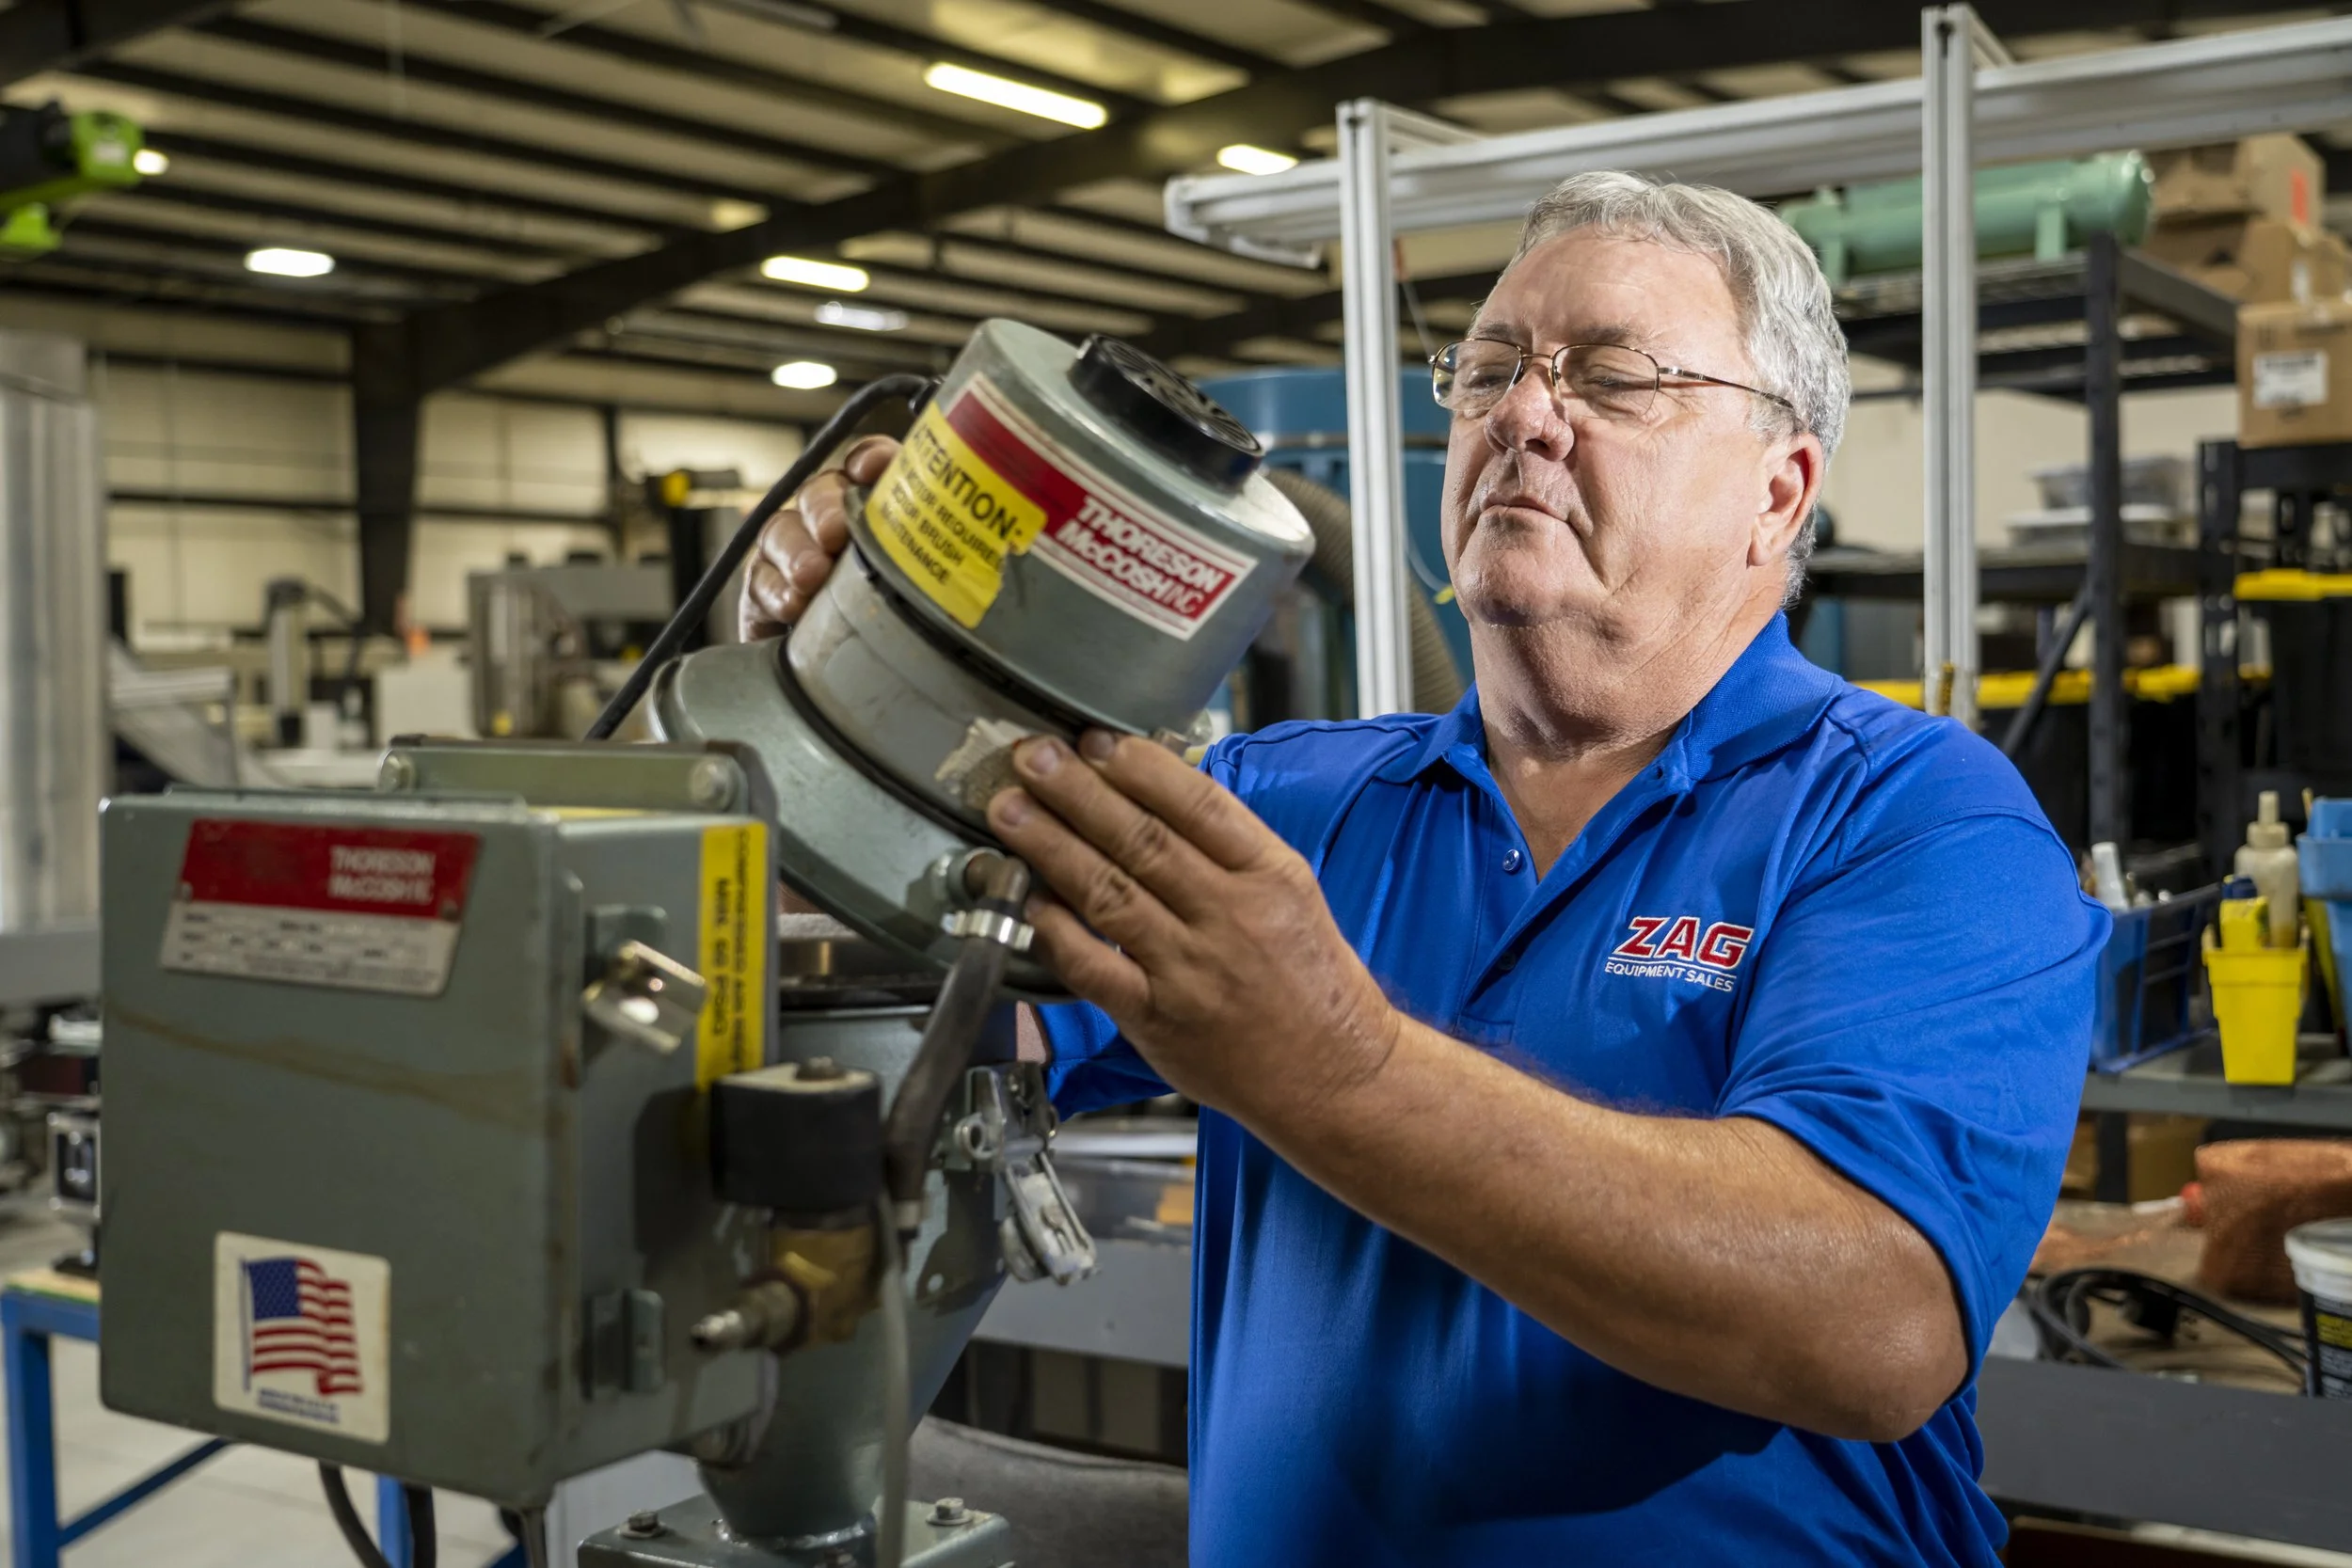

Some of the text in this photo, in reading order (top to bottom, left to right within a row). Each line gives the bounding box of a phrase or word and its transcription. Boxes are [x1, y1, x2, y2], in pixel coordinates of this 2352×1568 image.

[1077, 495, 1226, 594] THORESON
[1613, 916, 1754, 970] ZAG
[1605, 961, 1735, 992] EQUIPMENT SALES
